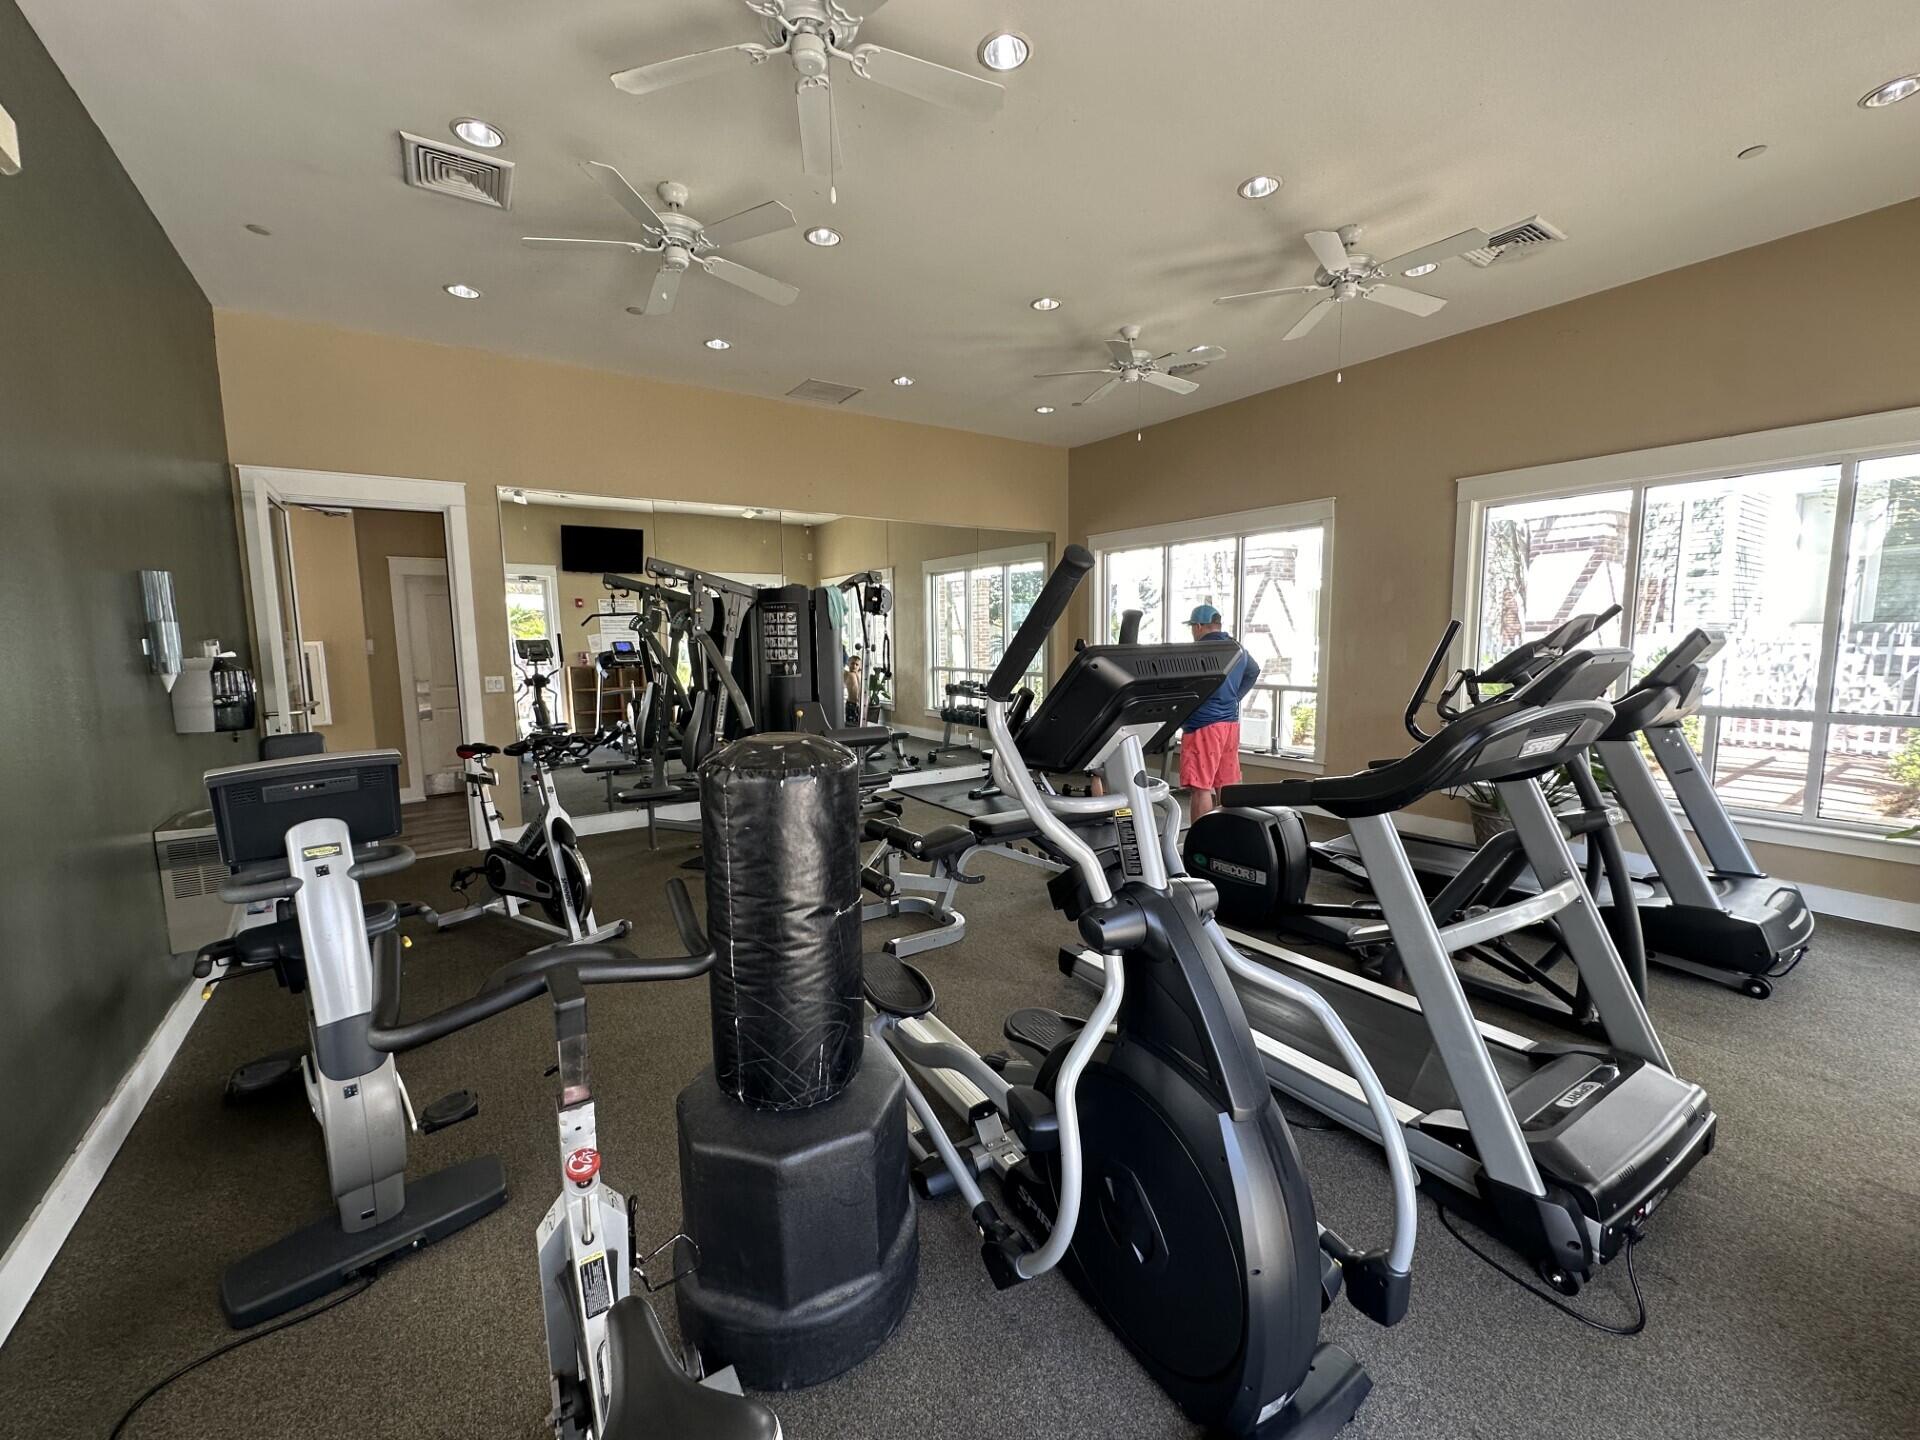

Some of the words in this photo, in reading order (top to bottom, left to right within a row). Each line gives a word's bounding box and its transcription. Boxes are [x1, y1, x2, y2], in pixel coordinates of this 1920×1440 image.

[1211, 860, 1250, 880] PRECOR
[1562, 1083, 1595, 1105] SPIRIT
[1017, 1184, 1053, 1233] SPIR
